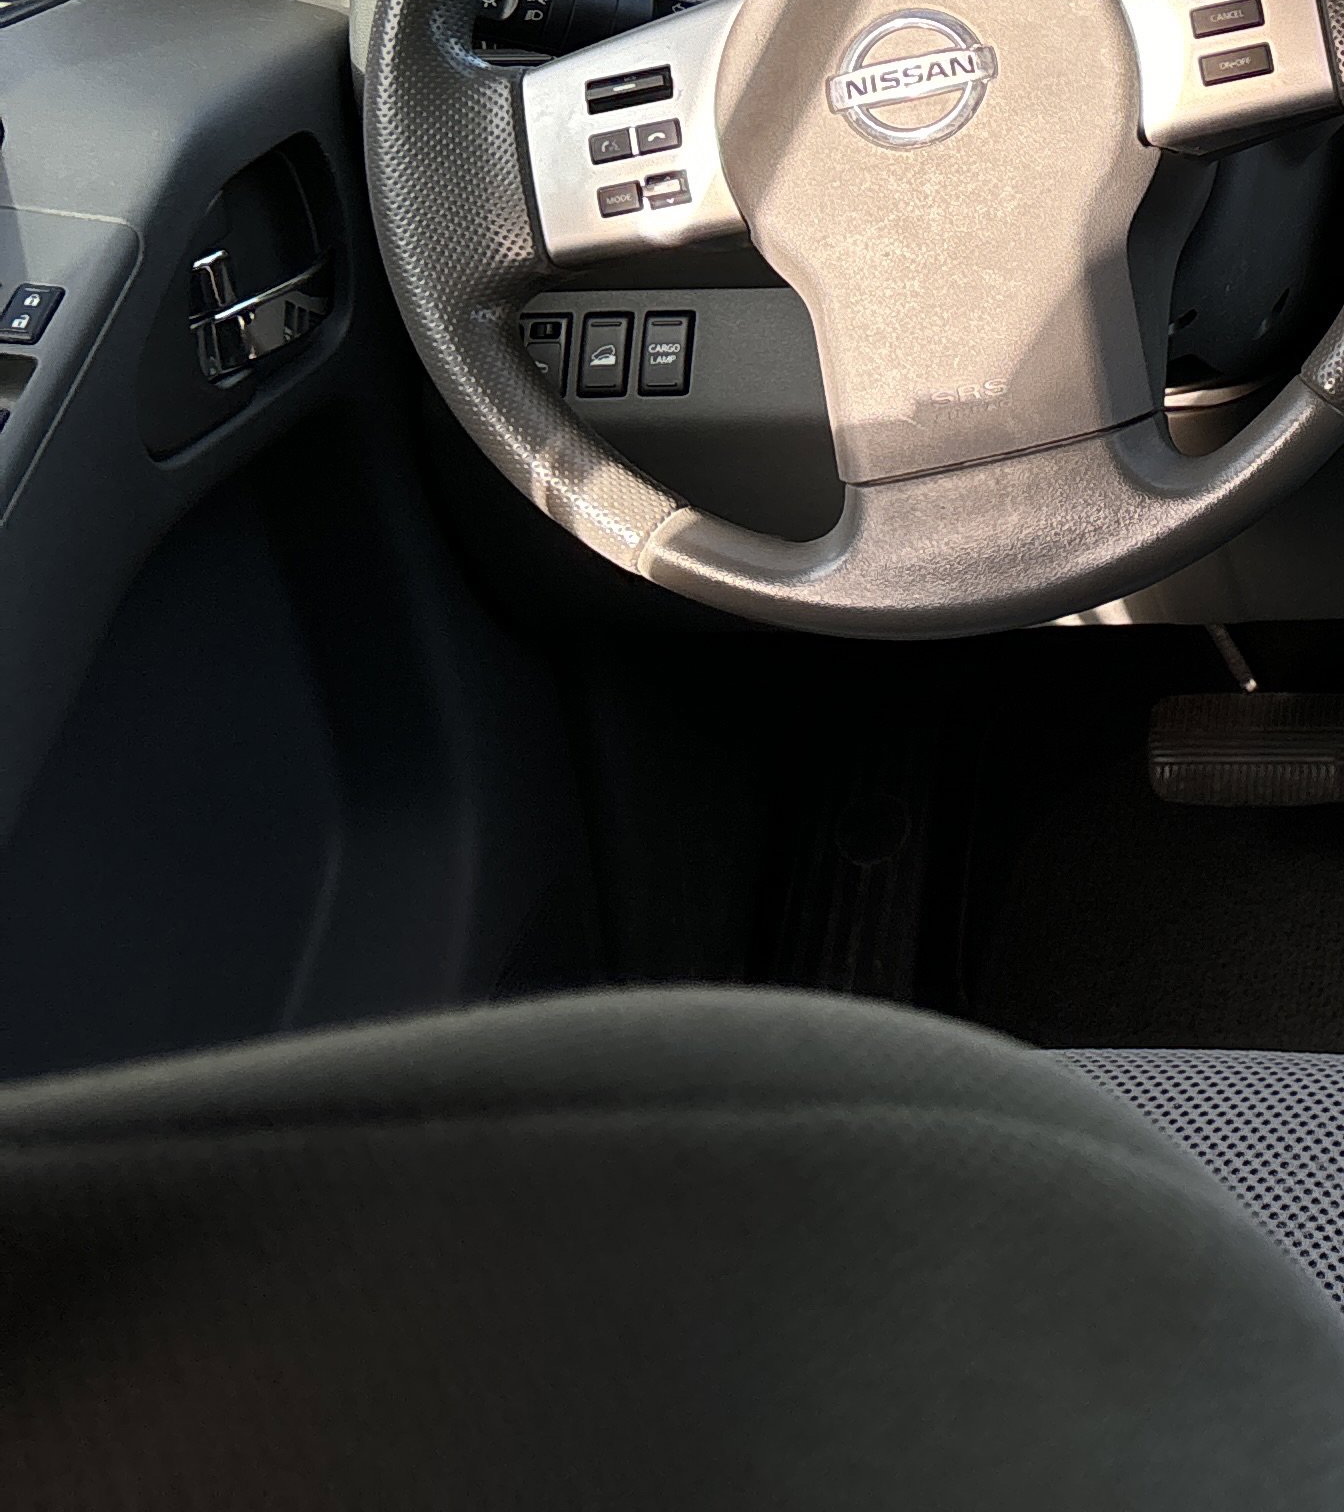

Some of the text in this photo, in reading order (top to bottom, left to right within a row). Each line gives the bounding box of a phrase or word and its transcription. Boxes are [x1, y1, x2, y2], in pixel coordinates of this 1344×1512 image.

[1210, 9, 1245, 23] CANCEL
[845, 54, 976, 101] NISSAN
[606, 193, 633, 205] MODE
[648, 343, 681, 353] CARGO
[650, 354, 677, 365] LAMP
